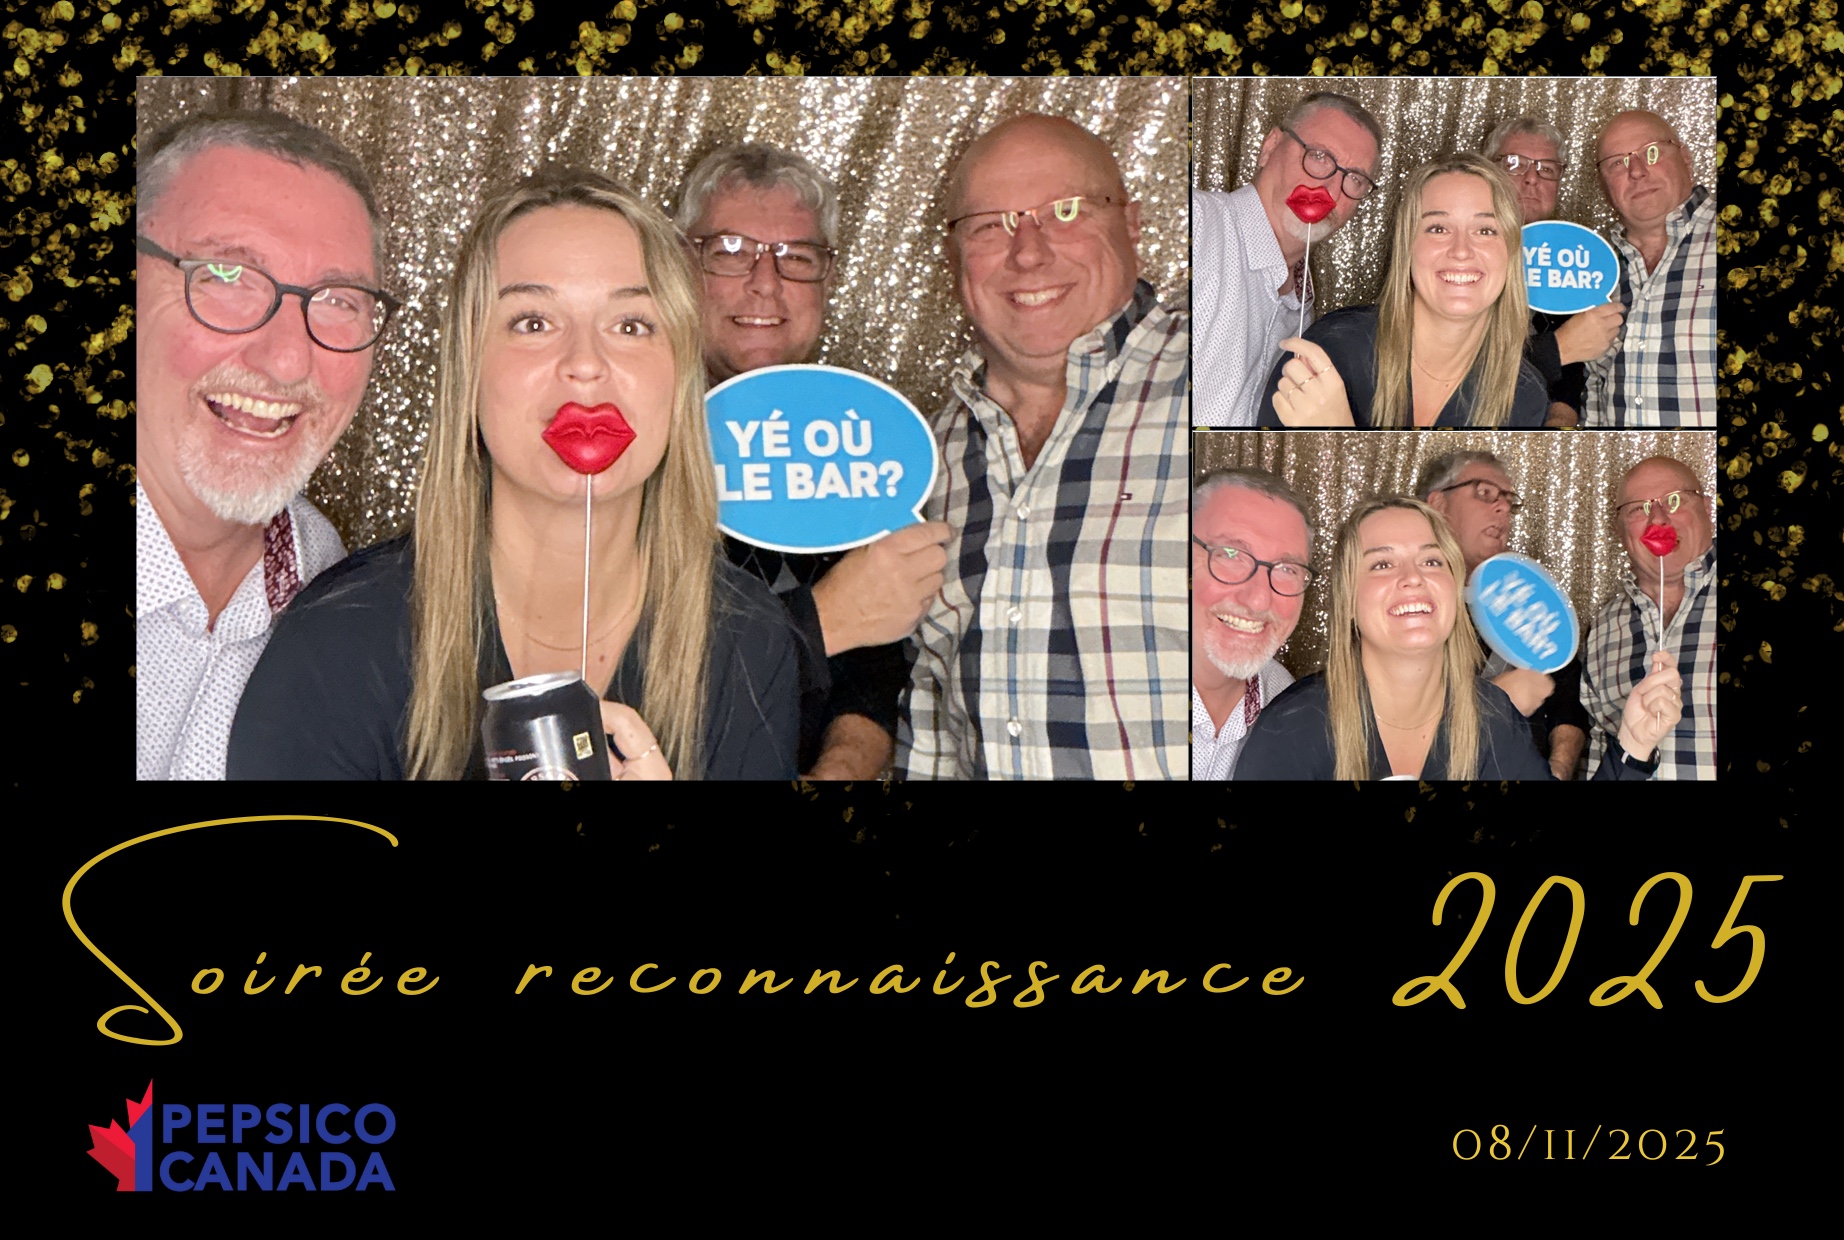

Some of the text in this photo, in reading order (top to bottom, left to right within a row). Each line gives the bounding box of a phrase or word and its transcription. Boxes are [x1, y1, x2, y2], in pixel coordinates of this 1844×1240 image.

[1522, 242, 1590, 269] YÉ OÙ
[1524, 268, 1604, 290] E BAR?
[724, 408, 873, 458] YÉ OÙ
[714, 460, 904, 502] LE BAR?
